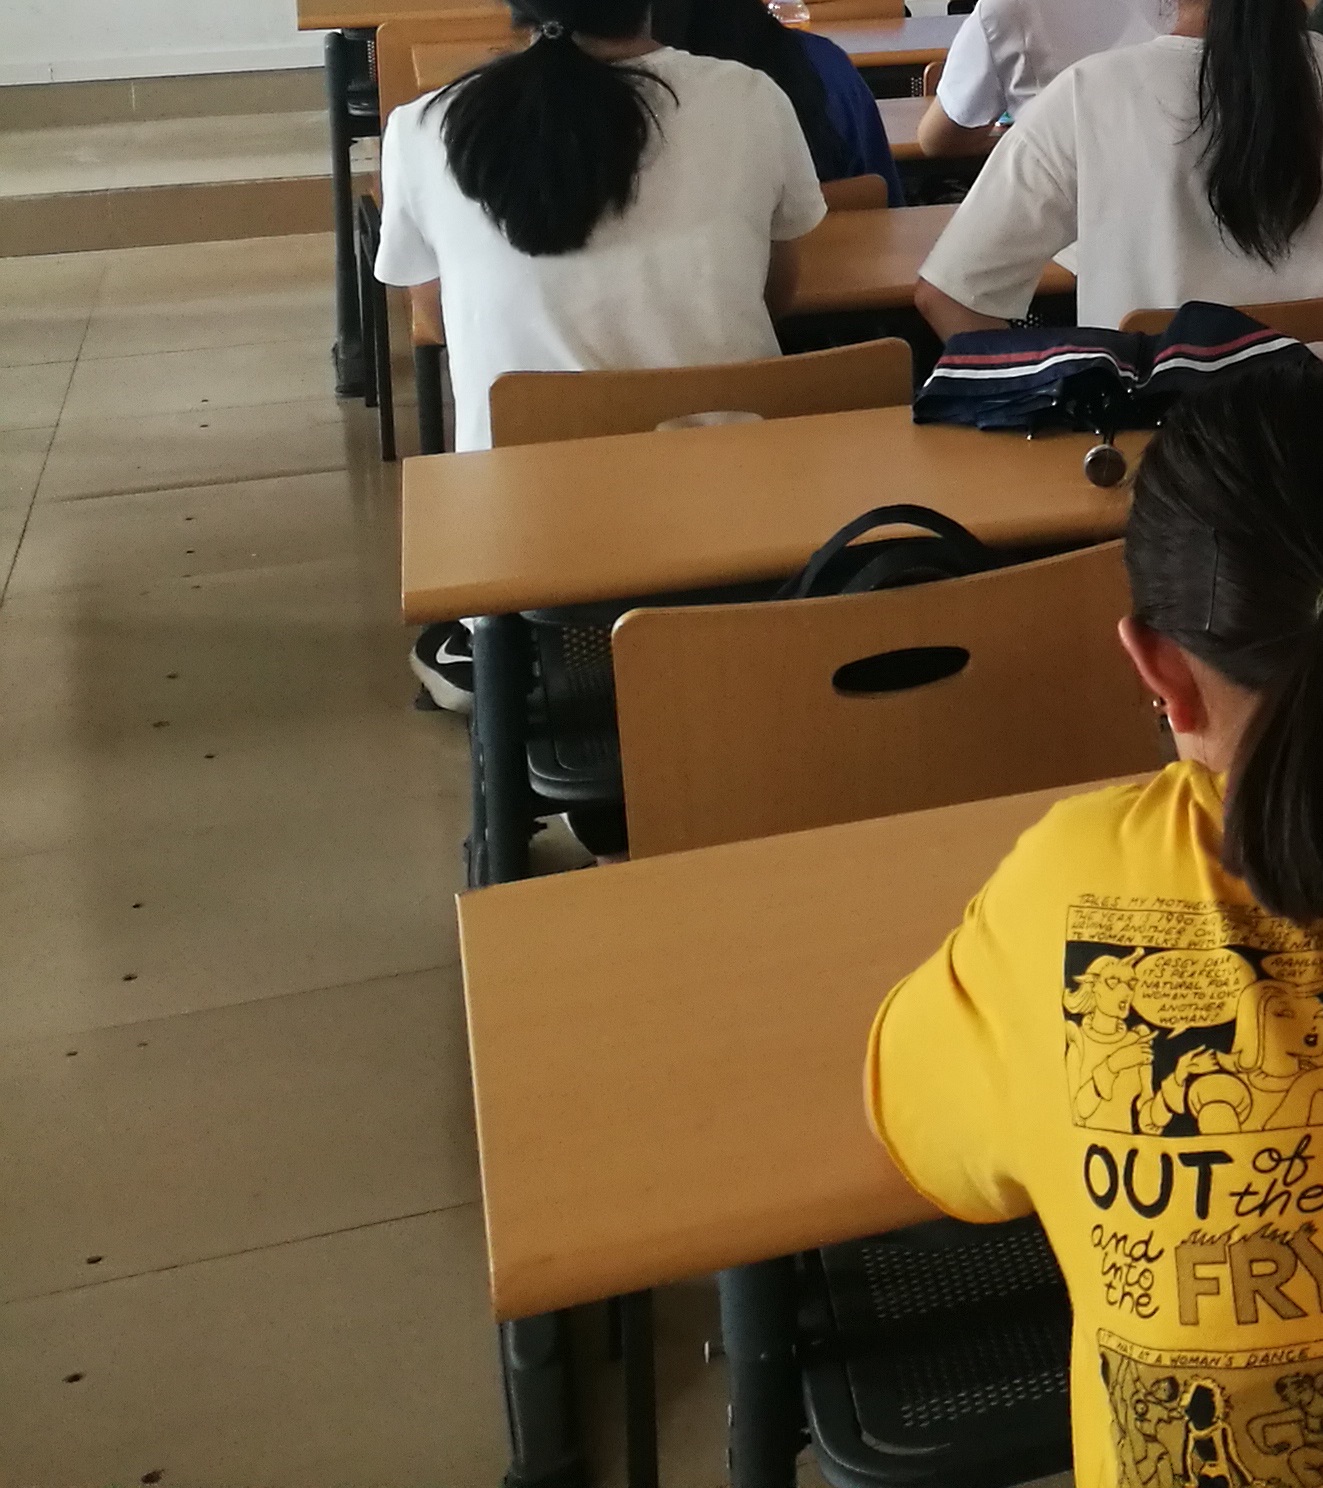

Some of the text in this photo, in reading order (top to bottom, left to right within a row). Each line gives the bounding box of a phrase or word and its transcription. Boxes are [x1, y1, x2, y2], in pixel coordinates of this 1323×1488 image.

[1084, 1144, 1233, 1220] OUT
[1251, 1133, 1315, 1191] of
[1090, 1224, 1164, 1264] and
[1101, 1247, 1156, 1292] into
[1104, 1285, 1160, 1320] the
